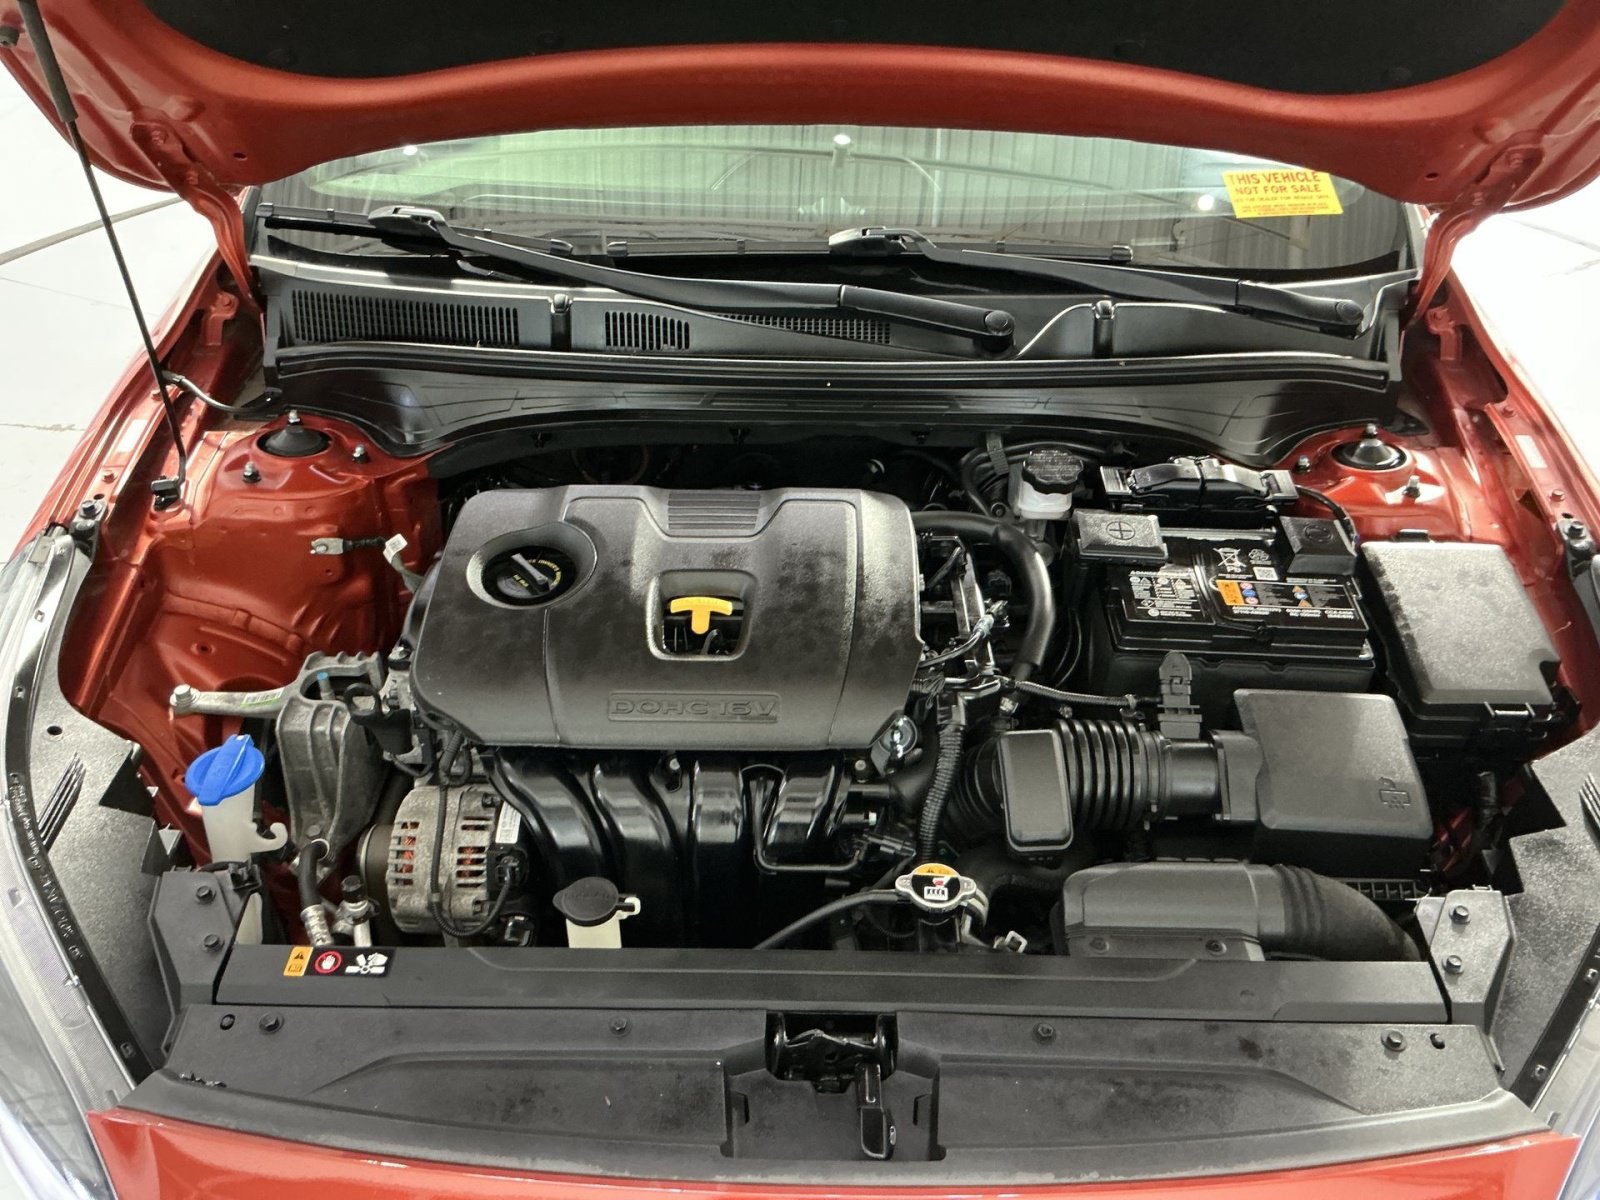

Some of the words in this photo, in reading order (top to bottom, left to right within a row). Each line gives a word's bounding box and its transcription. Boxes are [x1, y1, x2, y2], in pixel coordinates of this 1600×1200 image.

[1228, 173, 1260, 185] THIS
[1262, 171, 1321, 184] VEHICLE
[1234, 186, 1258, 195] NOT
[1263, 185, 1288, 194] FOR
[1290, 184, 1322, 193] SALE
[611, 700, 709, 716] DOHC
[719, 700, 777, 716] 16V
